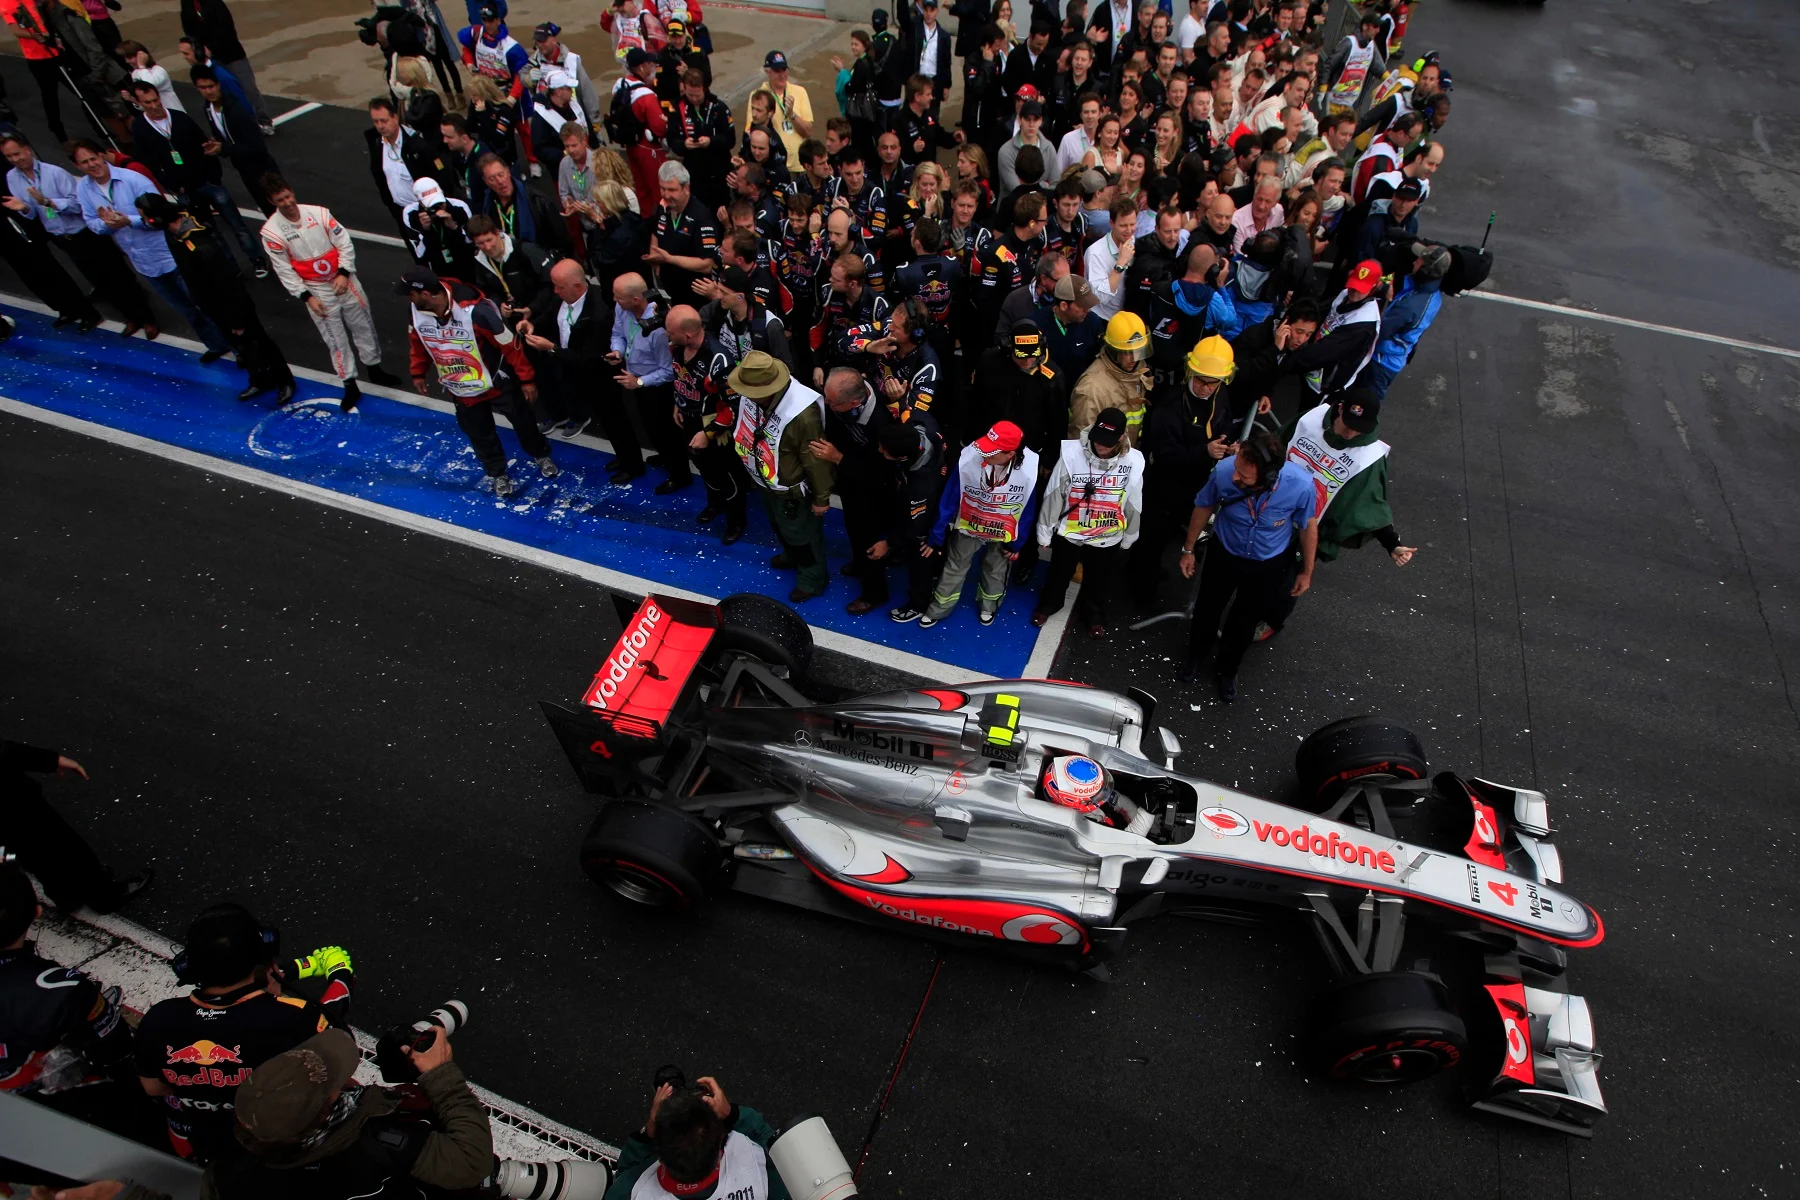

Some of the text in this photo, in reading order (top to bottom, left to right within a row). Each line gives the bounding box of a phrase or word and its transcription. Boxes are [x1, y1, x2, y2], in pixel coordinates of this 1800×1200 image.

[1339, 452, 1354, 467] 2011
[1009, 485, 1025, 493] 2011
[982, 526, 1007, 539] TIMES
[984, 519, 1005, 530] LANE
[1095, 519, 1119, 529] TIMES
[589, 604, 662, 710] vodafone
[589, 739, 614, 760] 4
[832, 718, 904, 754] Mobil
[818, 736, 919, 776] Mercedes-Benz
[983, 745, 1019, 762] BOSS
[1252, 819, 1396, 874] vodafone
[1466, 863, 1481, 904] PIRELLI
[1487, 880, 1519, 907] 4
[1526, 883, 1542, 919] Mobil
[866, 895, 994, 938] vodafone
